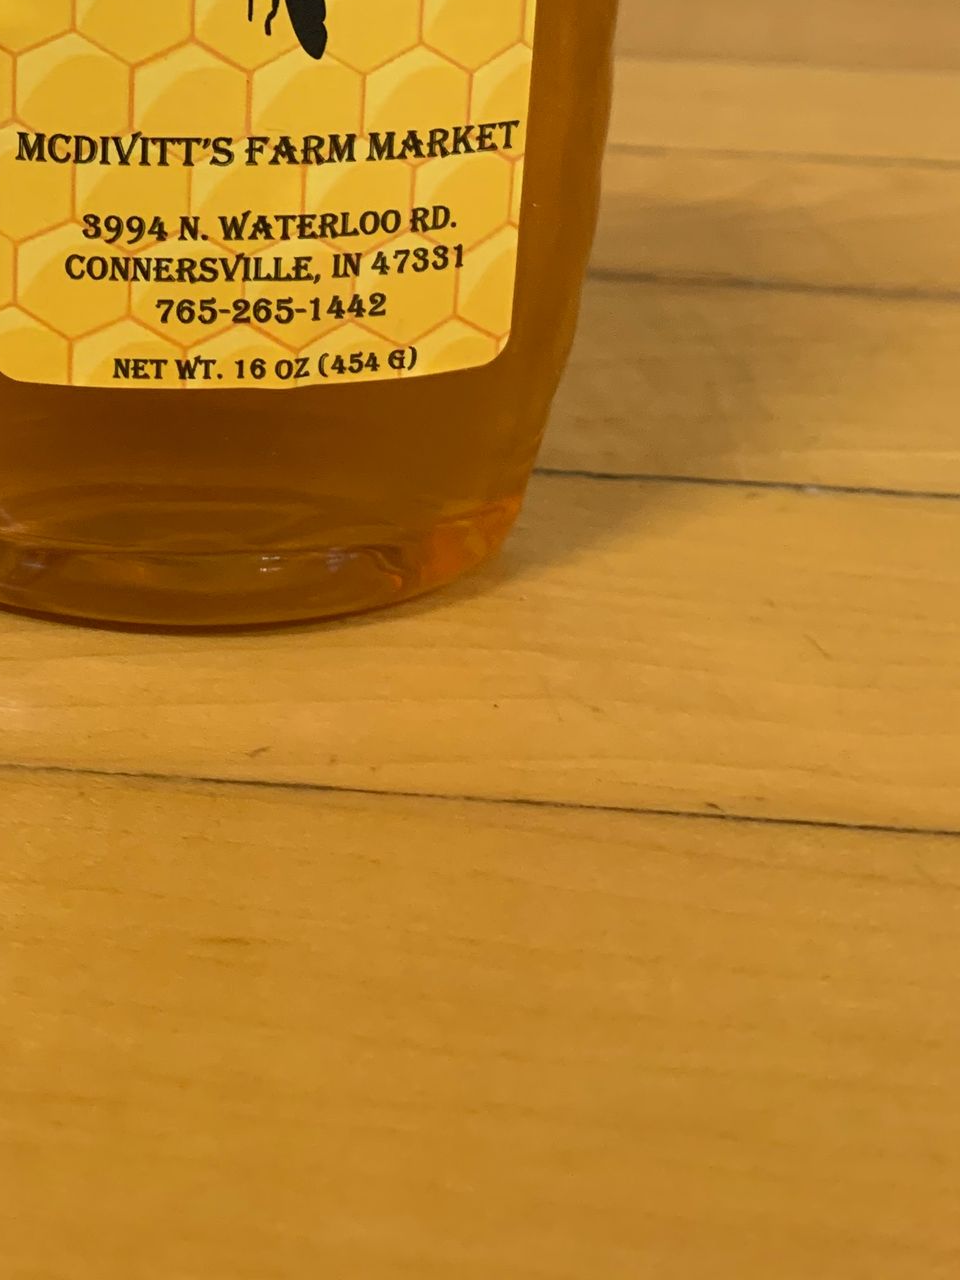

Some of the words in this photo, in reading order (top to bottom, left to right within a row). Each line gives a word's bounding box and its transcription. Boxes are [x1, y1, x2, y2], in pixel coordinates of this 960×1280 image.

[15, 131, 235, 167] MCDIVITT'S
[244, 133, 357, 166] FARM
[366, 119, 520, 161] MARKET
[82, 213, 168, 245] 3994
[178, 216, 209, 241] N.
[218, 209, 401, 241] WATERLOO
[409, 205, 457, 233] RD.
[64, 252, 321, 284] CONNERSVILLE,
[332, 252, 362, 278] IN
[371, 243, 463, 275] 47331
[155, 292, 387, 325] 765-265-1442
[112, 358, 168, 380] NET
[174, 355, 223, 380] WT.
[234, 358, 266, 380] 16
[274, 357, 310, 380] OZ
[318, 351, 380, 378] (454
[387, 346, 418, 371] G)
